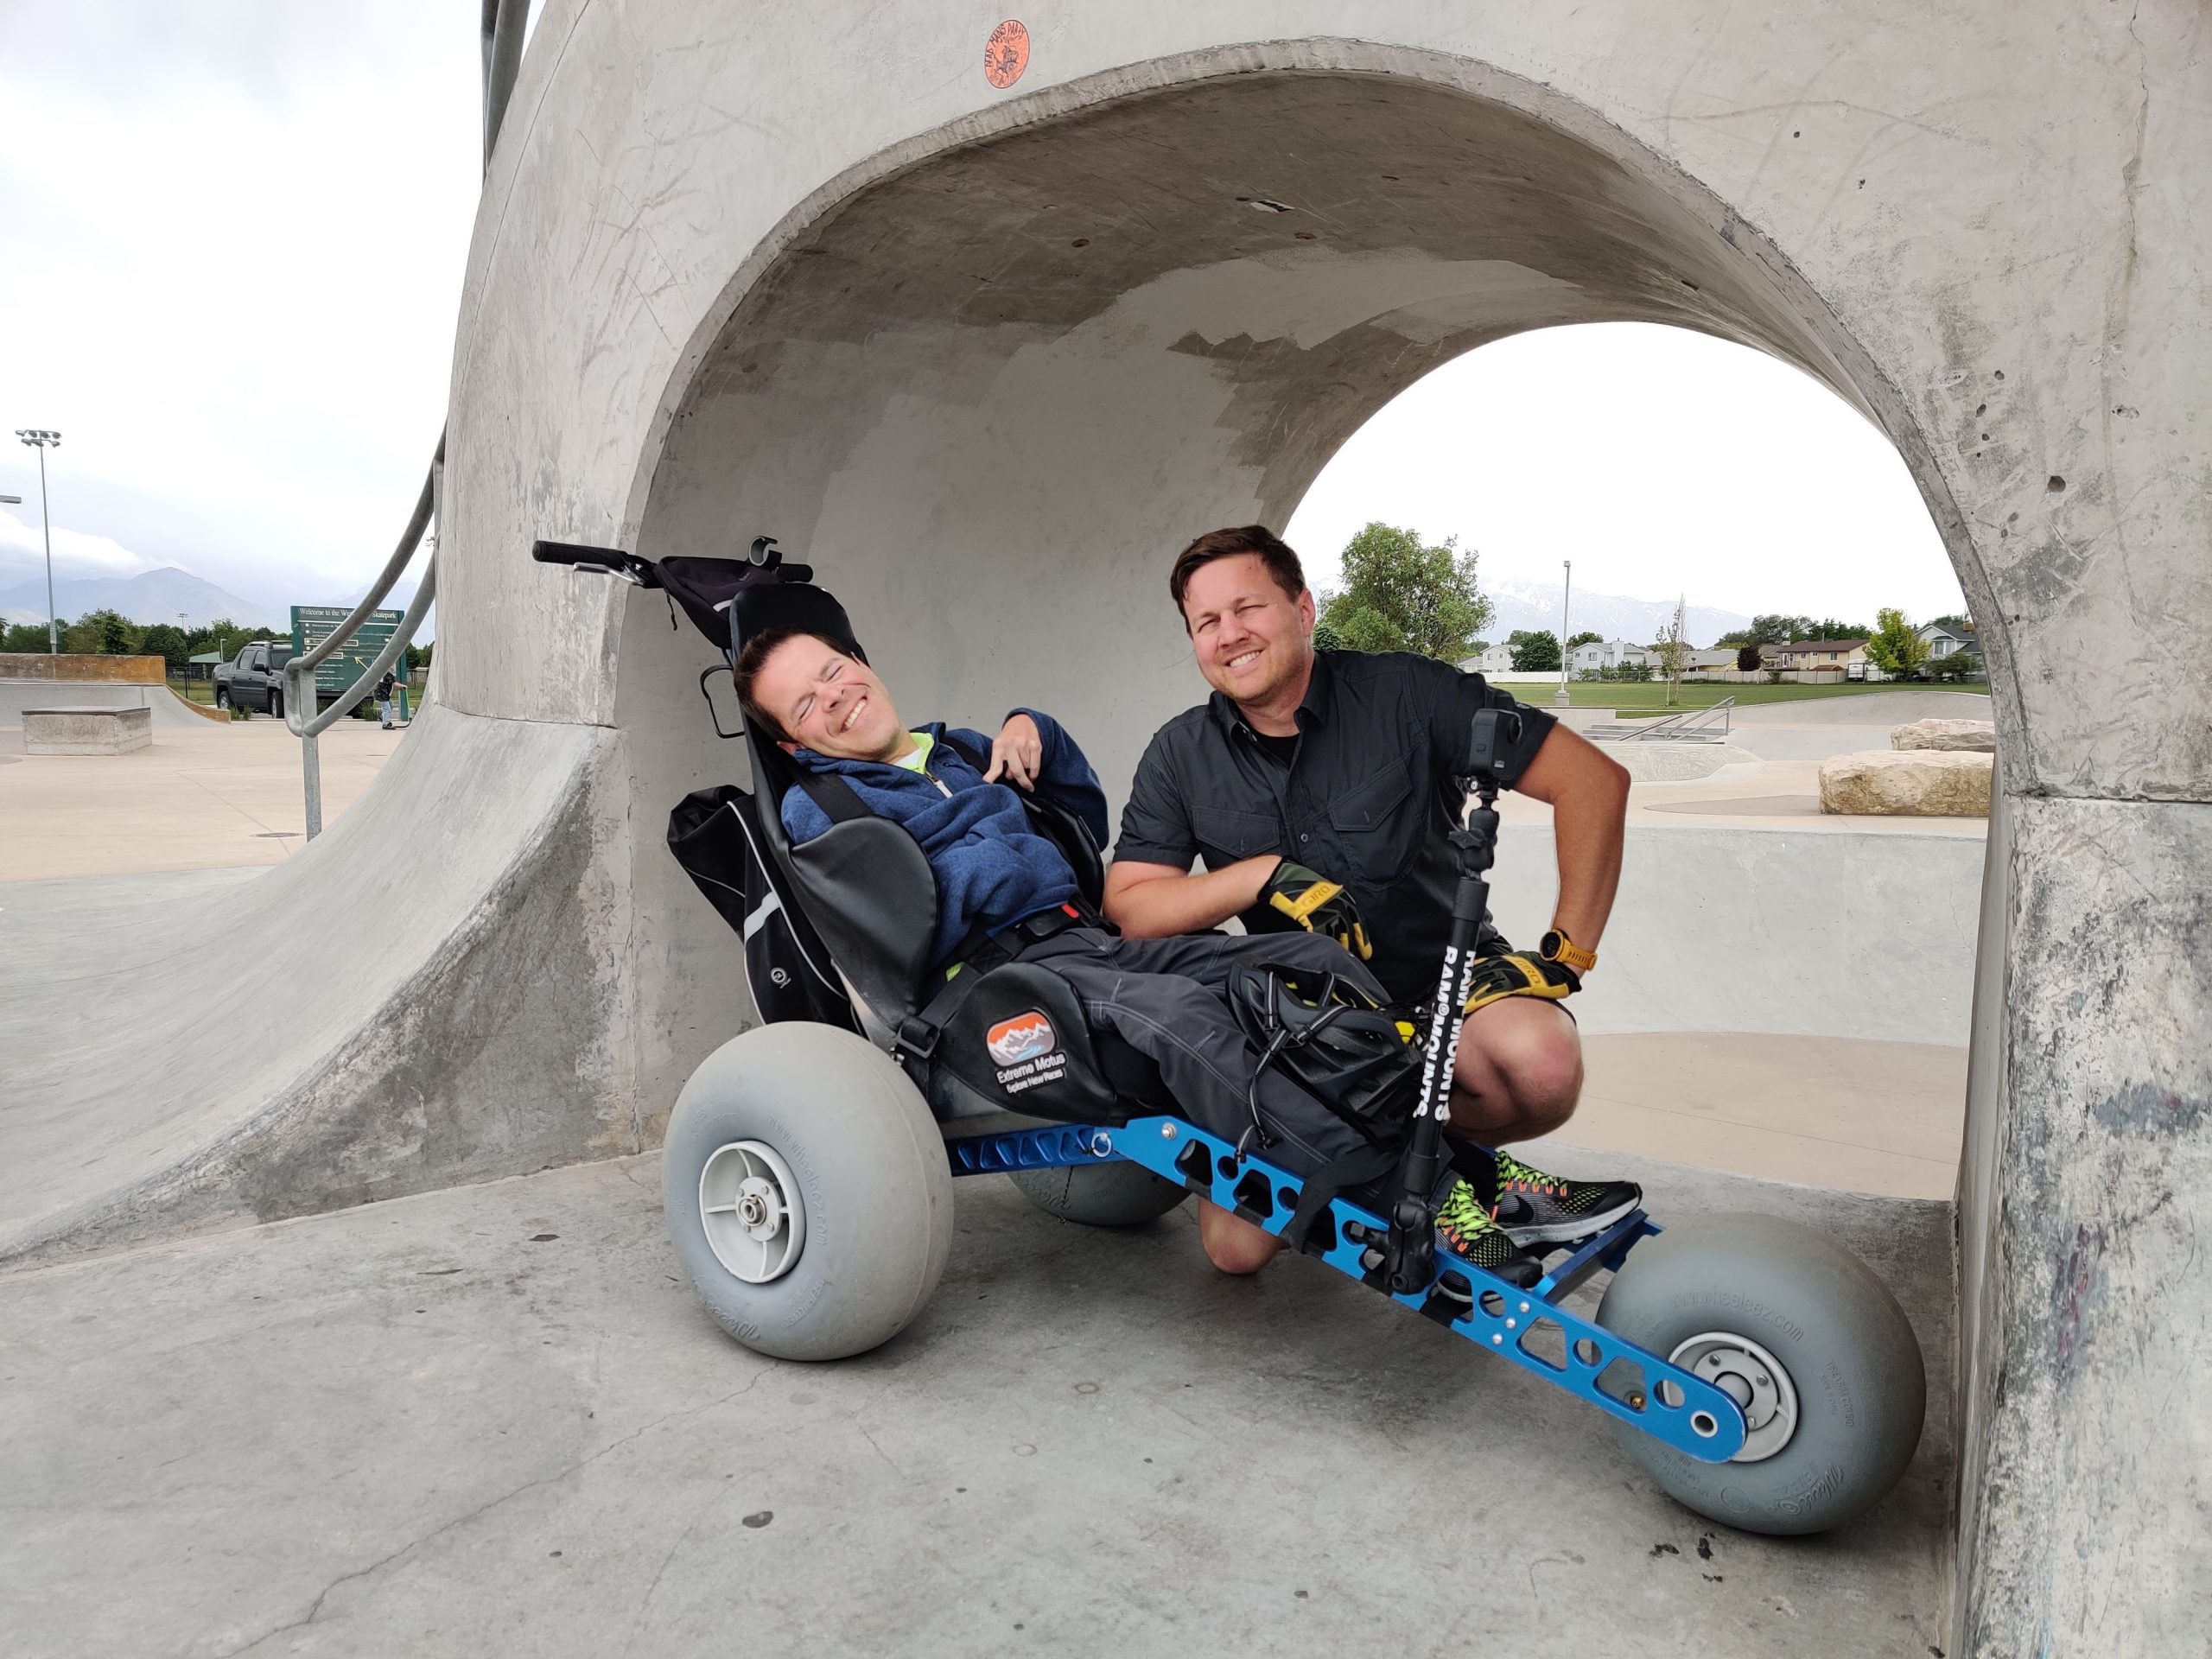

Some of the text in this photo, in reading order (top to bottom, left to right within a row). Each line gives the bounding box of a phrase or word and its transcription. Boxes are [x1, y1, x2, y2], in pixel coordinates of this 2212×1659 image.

[299, 607, 325, 617] Welcome
[331, 608, 340, 617] the
[1302, 884, 1331, 908] GIRO
[1515, 959, 1541, 984] GIRO
[996, 1053, 1066, 1084] Extreme Motus
[1413, 1014, 1445, 1119] MOUNTS
[1006, 1069, 1064, 1094] Explore New Places
